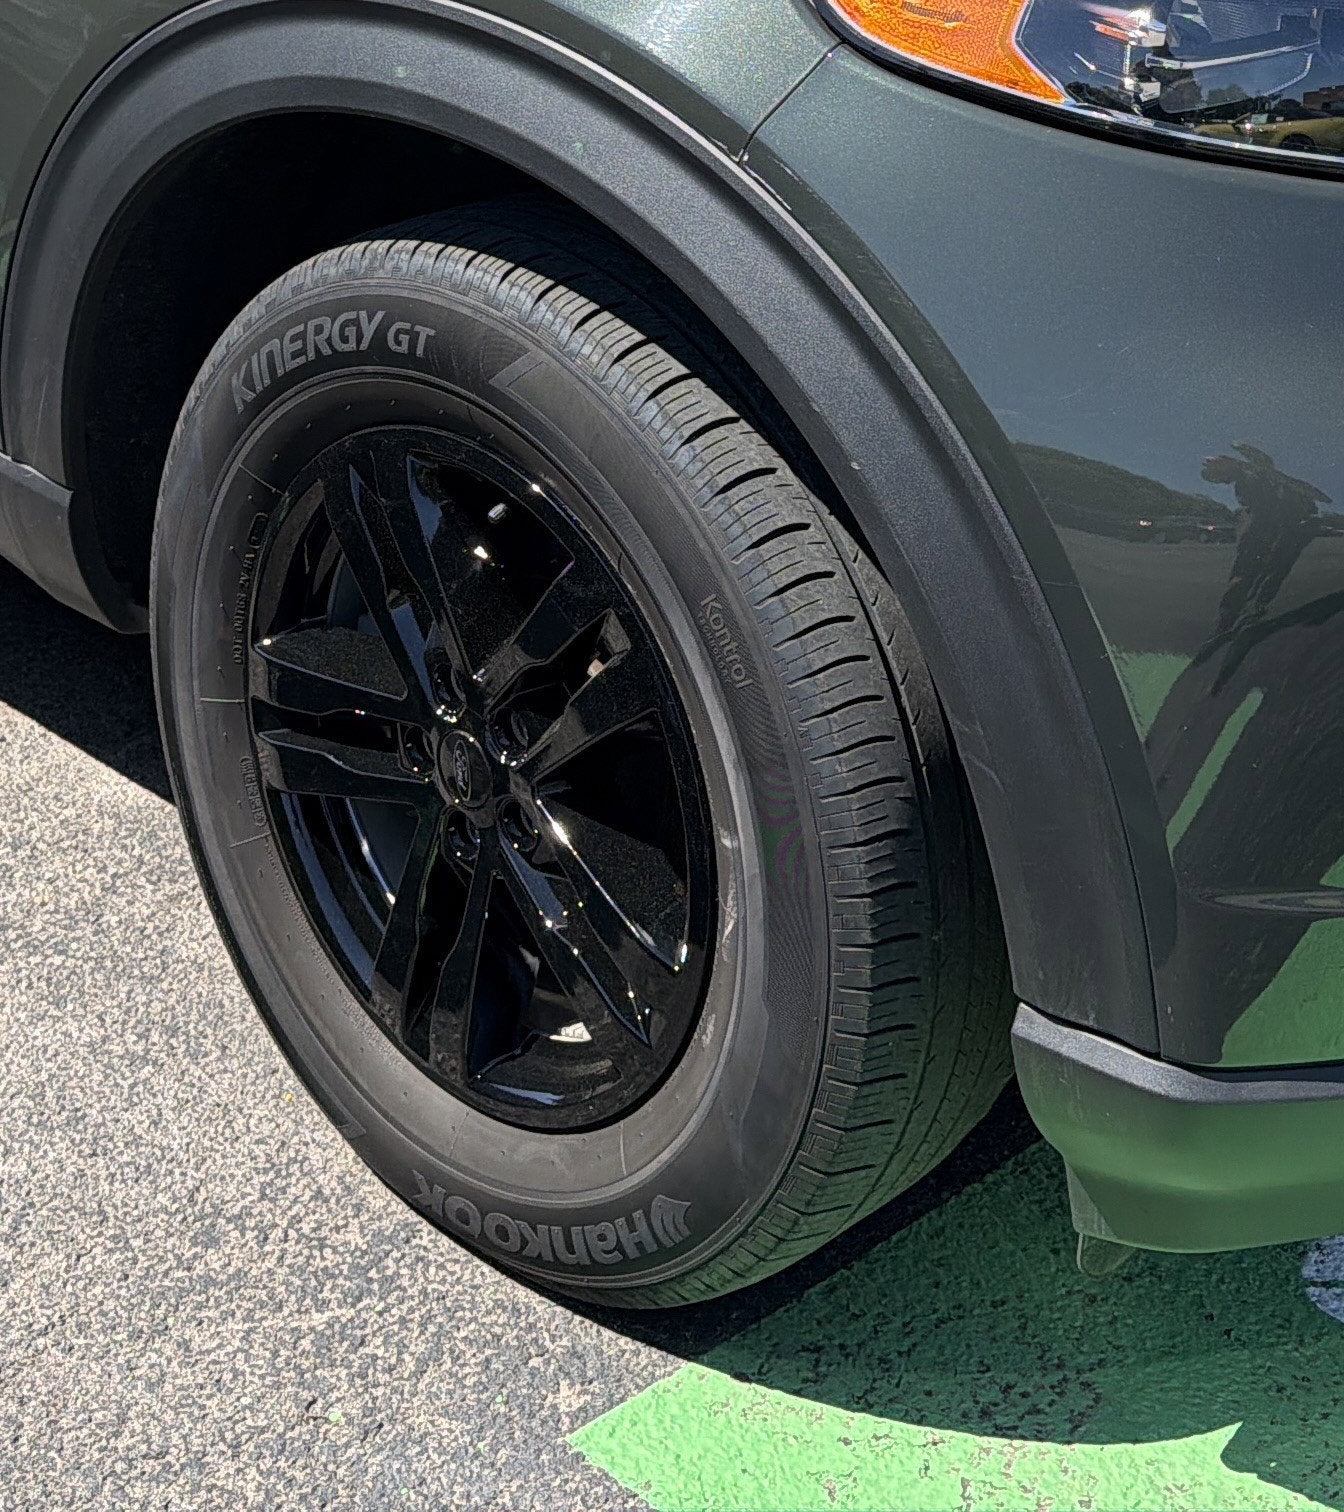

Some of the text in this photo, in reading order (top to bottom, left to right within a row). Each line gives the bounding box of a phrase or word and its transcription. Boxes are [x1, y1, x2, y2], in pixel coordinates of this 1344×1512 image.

[230, 310, 437, 415] KINERGY GT
[700, 593, 754, 688] Kontrol
